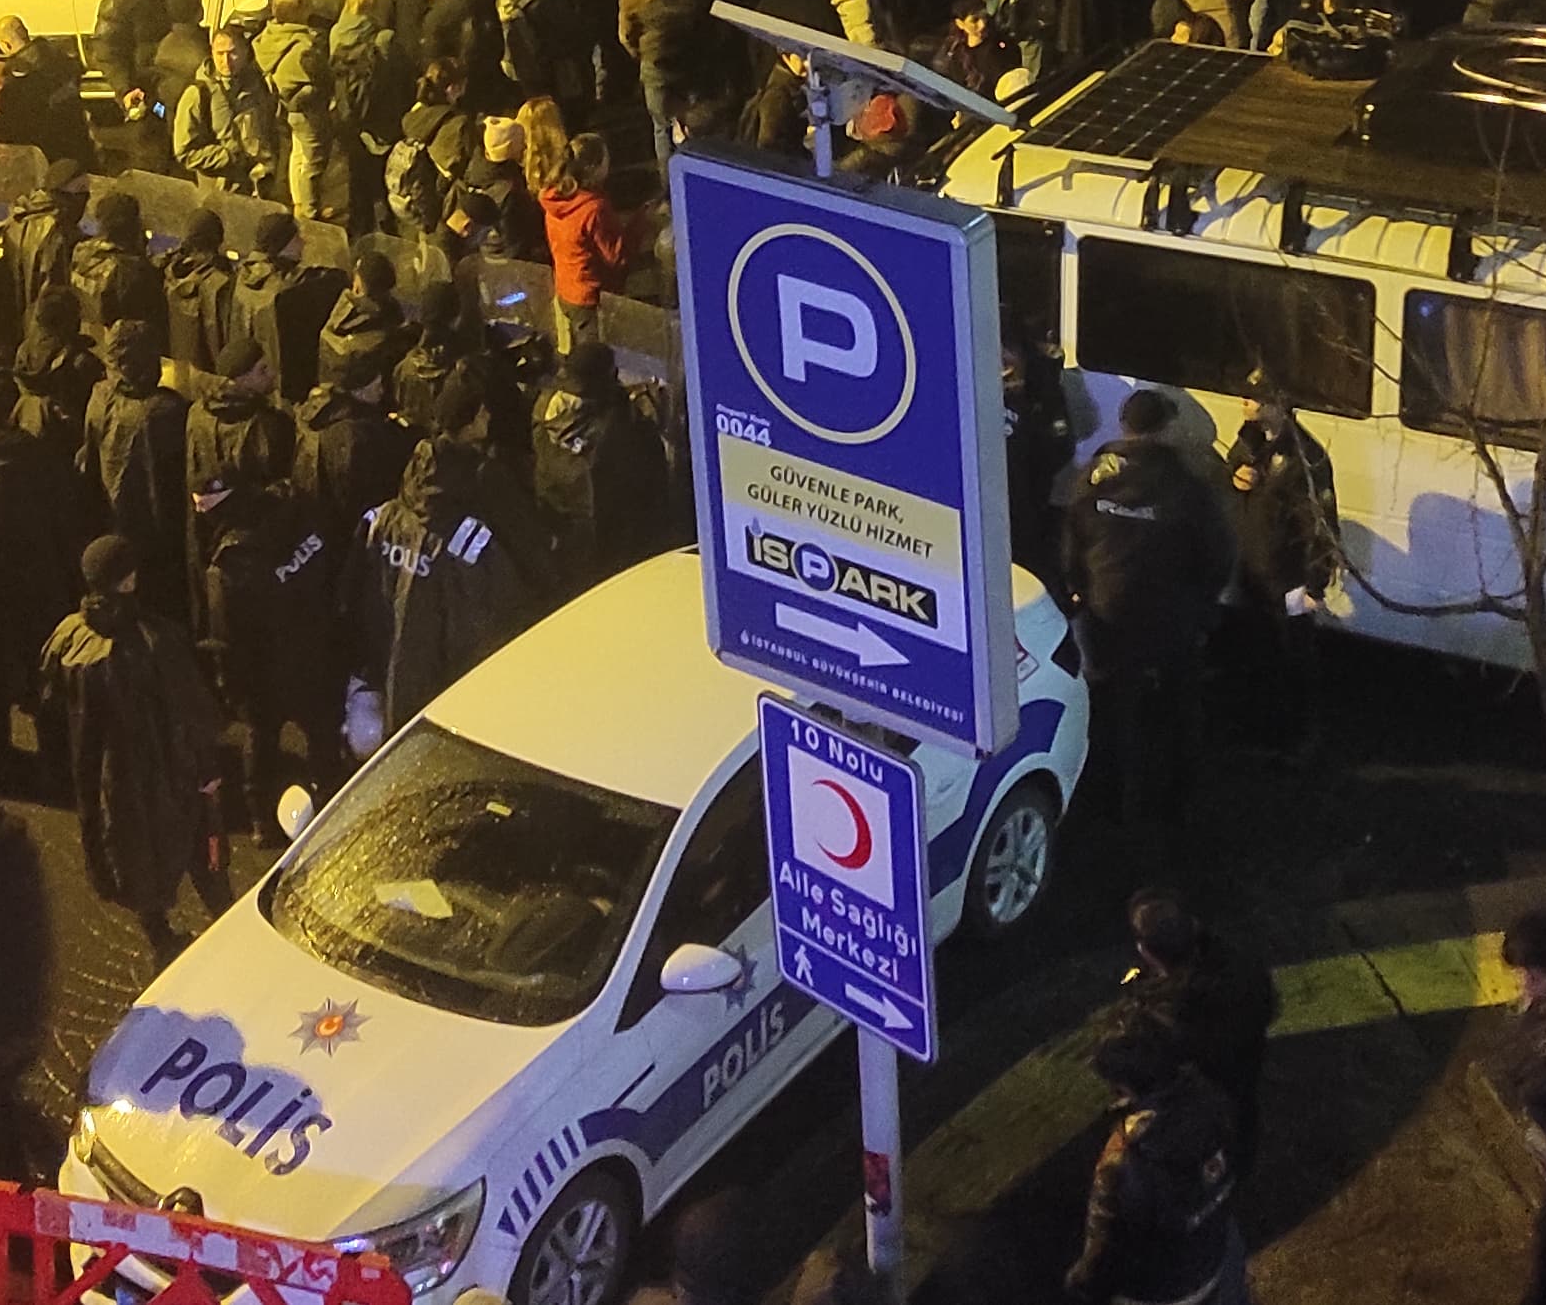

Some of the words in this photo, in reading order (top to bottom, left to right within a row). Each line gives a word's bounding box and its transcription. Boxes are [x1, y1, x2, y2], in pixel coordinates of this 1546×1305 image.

[777, 274, 878, 383] P
[716, 413, 772, 448] 0044
[747, 482, 803, 515] GÜLER
[805, 500, 862, 534] YÜZLÜ
[865, 522, 934, 560] HİZMET
[769, 464, 850, 504] GÜVENLE
[854, 491, 904, 524] PARK,
[751, 634, 809, 665] İSTANBUL
[891, 687, 965, 724] BELEDİYESİ
[790, 718, 820, 751] 10
[828, 737, 885, 784] Nolu
[779, 861, 825, 906] Aile
[830, 884, 918, 959] Sağlığı
[802, 906, 900, 984] Merkezi
[139, 1036, 333, 1176] POLİS
